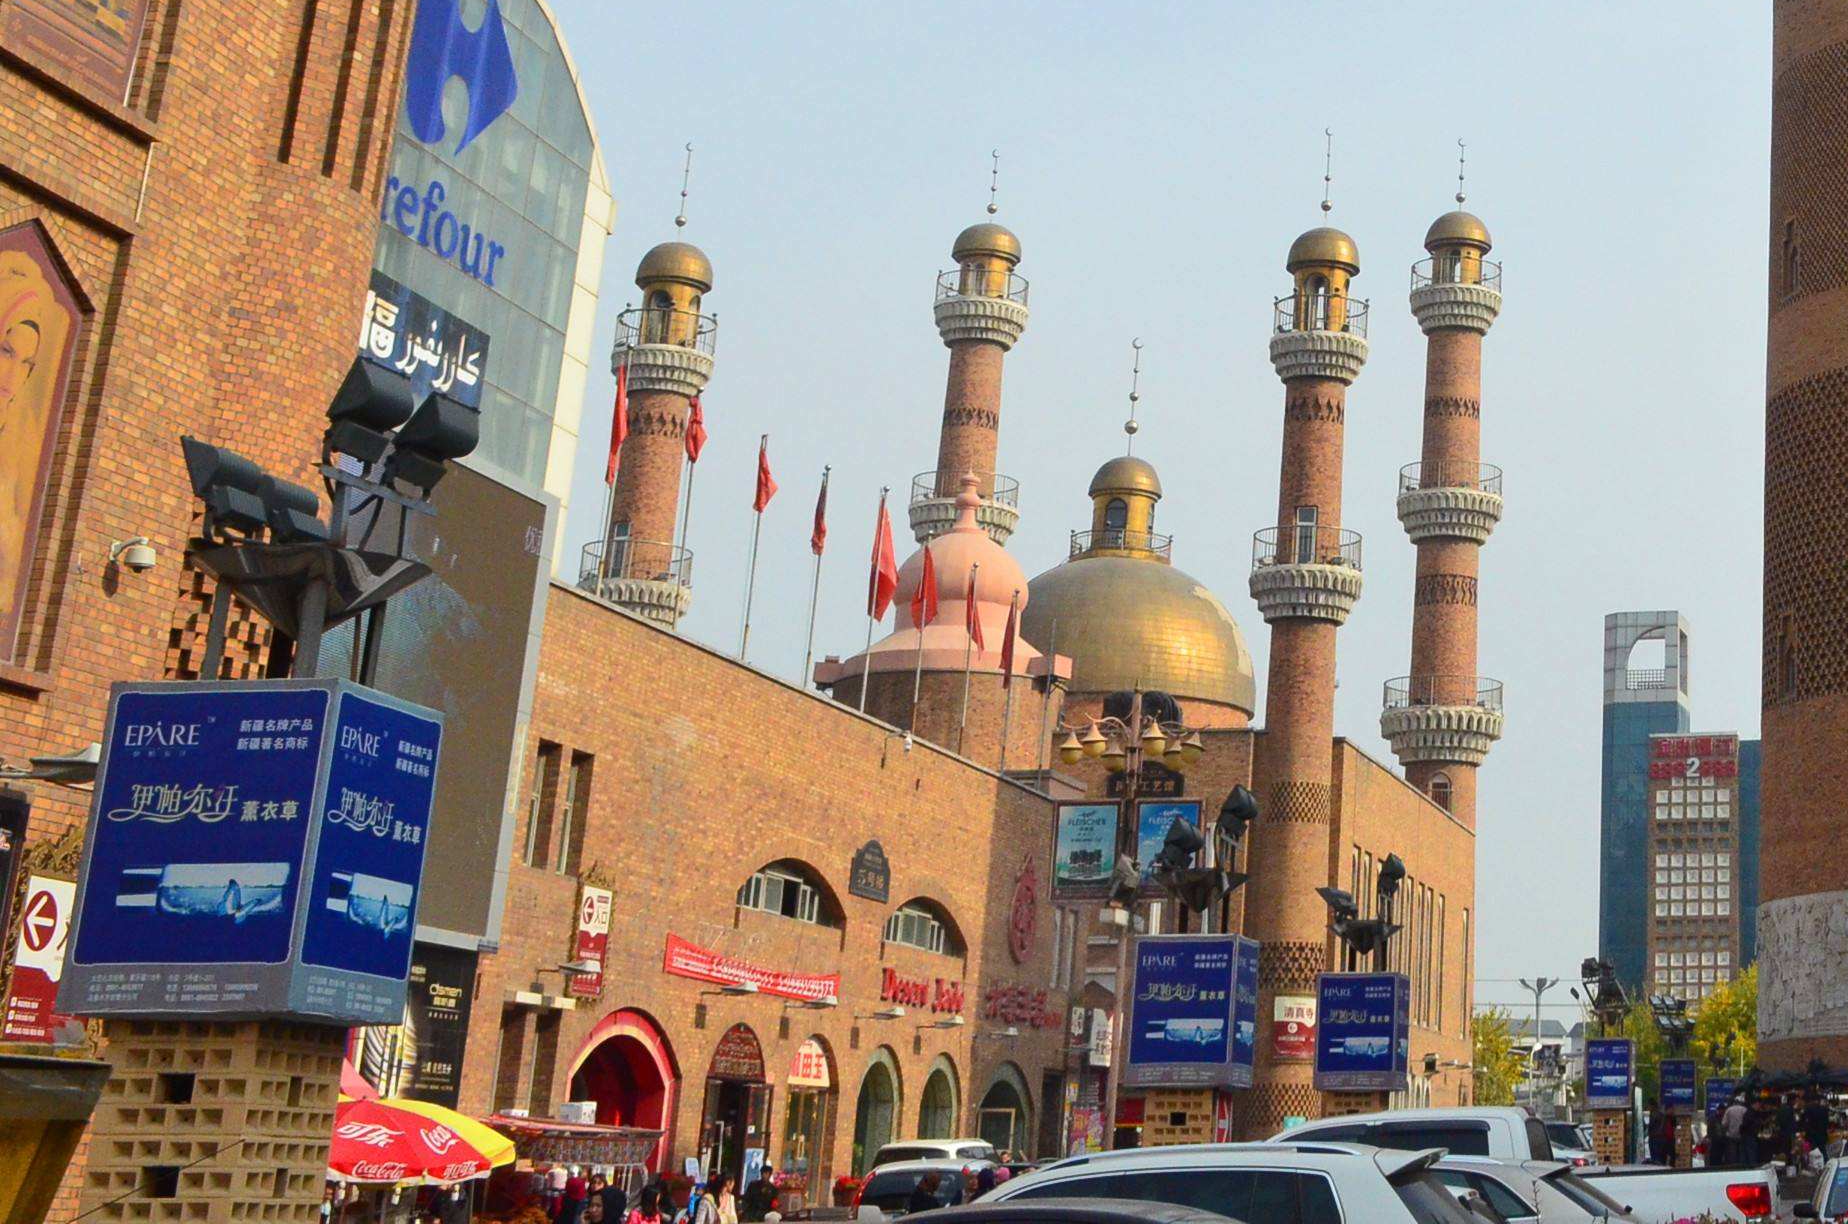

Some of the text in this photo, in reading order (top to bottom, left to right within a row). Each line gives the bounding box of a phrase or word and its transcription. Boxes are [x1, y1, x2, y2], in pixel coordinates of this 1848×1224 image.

[239, 718, 314, 733] 新疆名牌产品
[236, 736, 309, 751] 新疆著名商标
